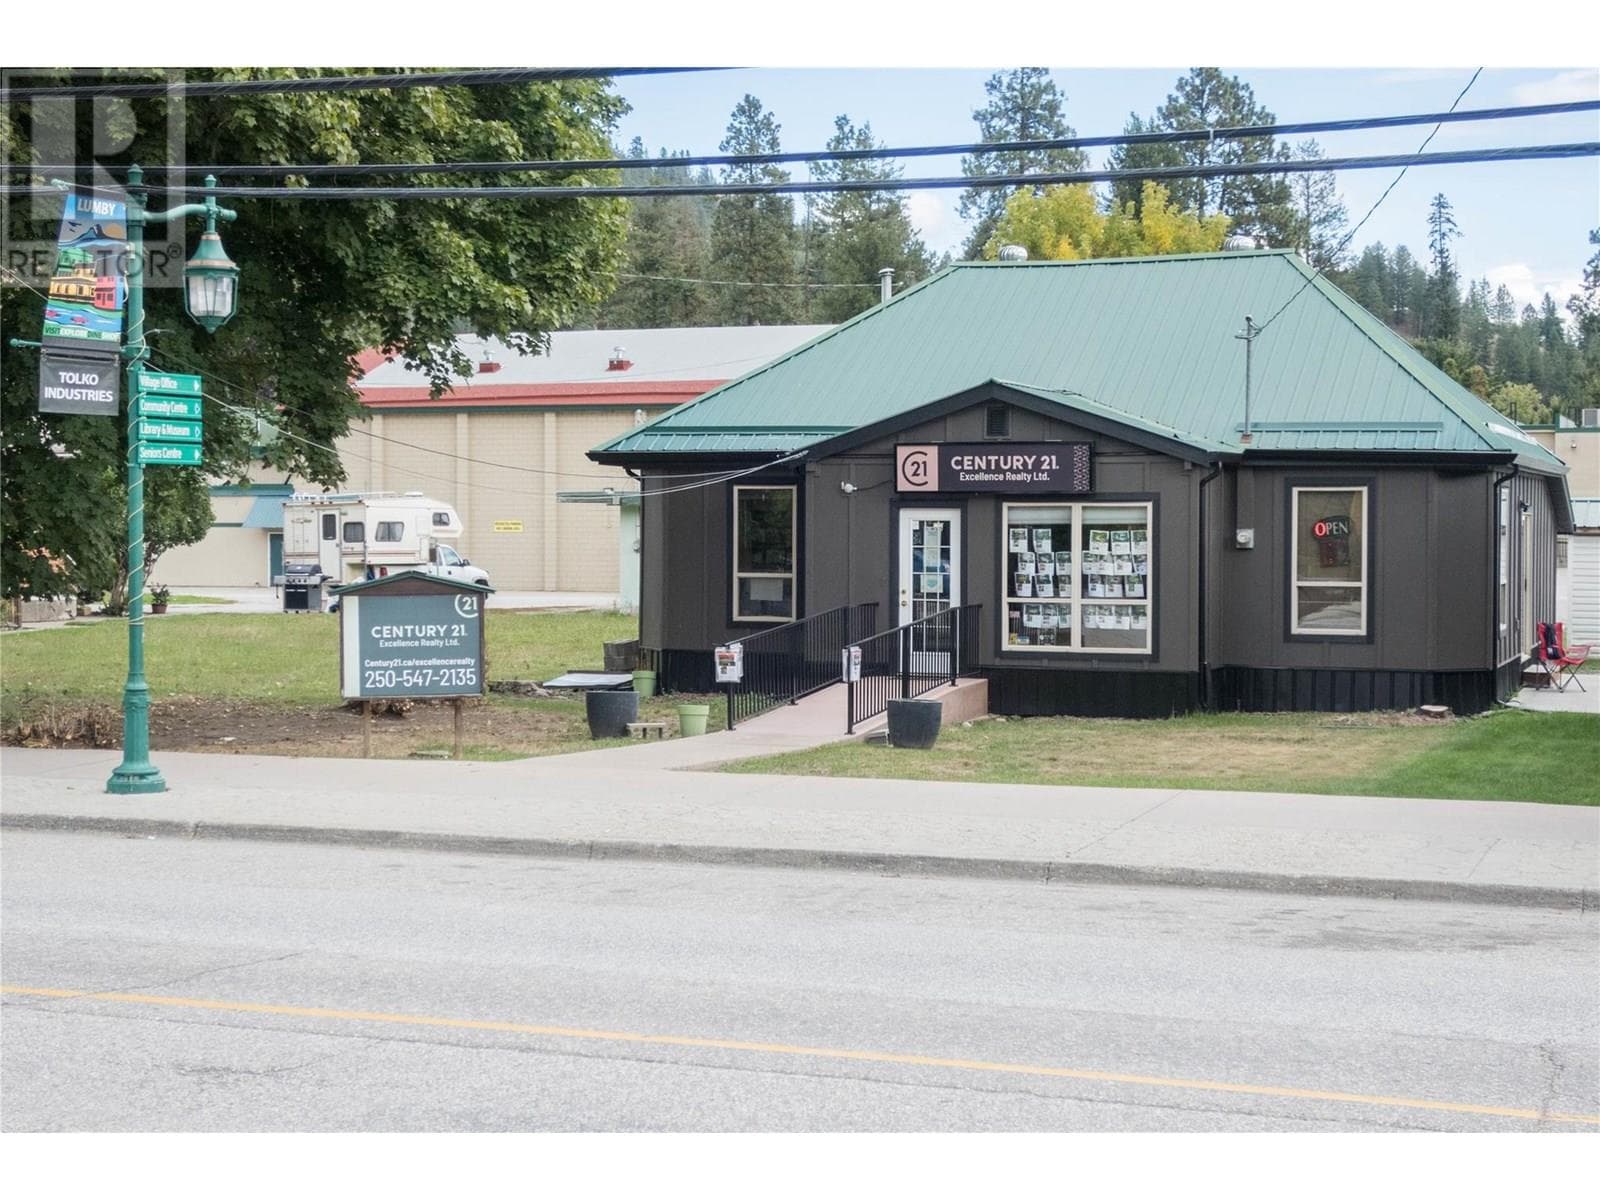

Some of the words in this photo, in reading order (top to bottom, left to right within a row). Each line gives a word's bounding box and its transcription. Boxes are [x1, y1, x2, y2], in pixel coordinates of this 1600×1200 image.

[77, 198, 116, 216] LUMBY
[58, 371, 99, 386] TOLKO
[44, 386, 114, 403] INDUSTRIES
[139, 422, 161, 438] Library
[139, 446, 162, 458] Seniors
[162, 447, 183, 459] Centre
[951, 455, 1037, 470] CENTURY
[960, 472, 1004, 481] Excellence
[1005, 472, 1032, 483] Realty
[1033, 472, 1050, 481] Ltd.
[1314, 521, 1349, 537] OPEN
[371, 624, 448, 638] CENTURY
[379, 639, 419, 648] Excellence
[420, 639, 444, 648] Realty
[445, 638, 460, 647] Ltd.
[364, 657, 475, 669] Century21.ca/excellencerealty
[365, 668, 476, 688] 250-547-2135
